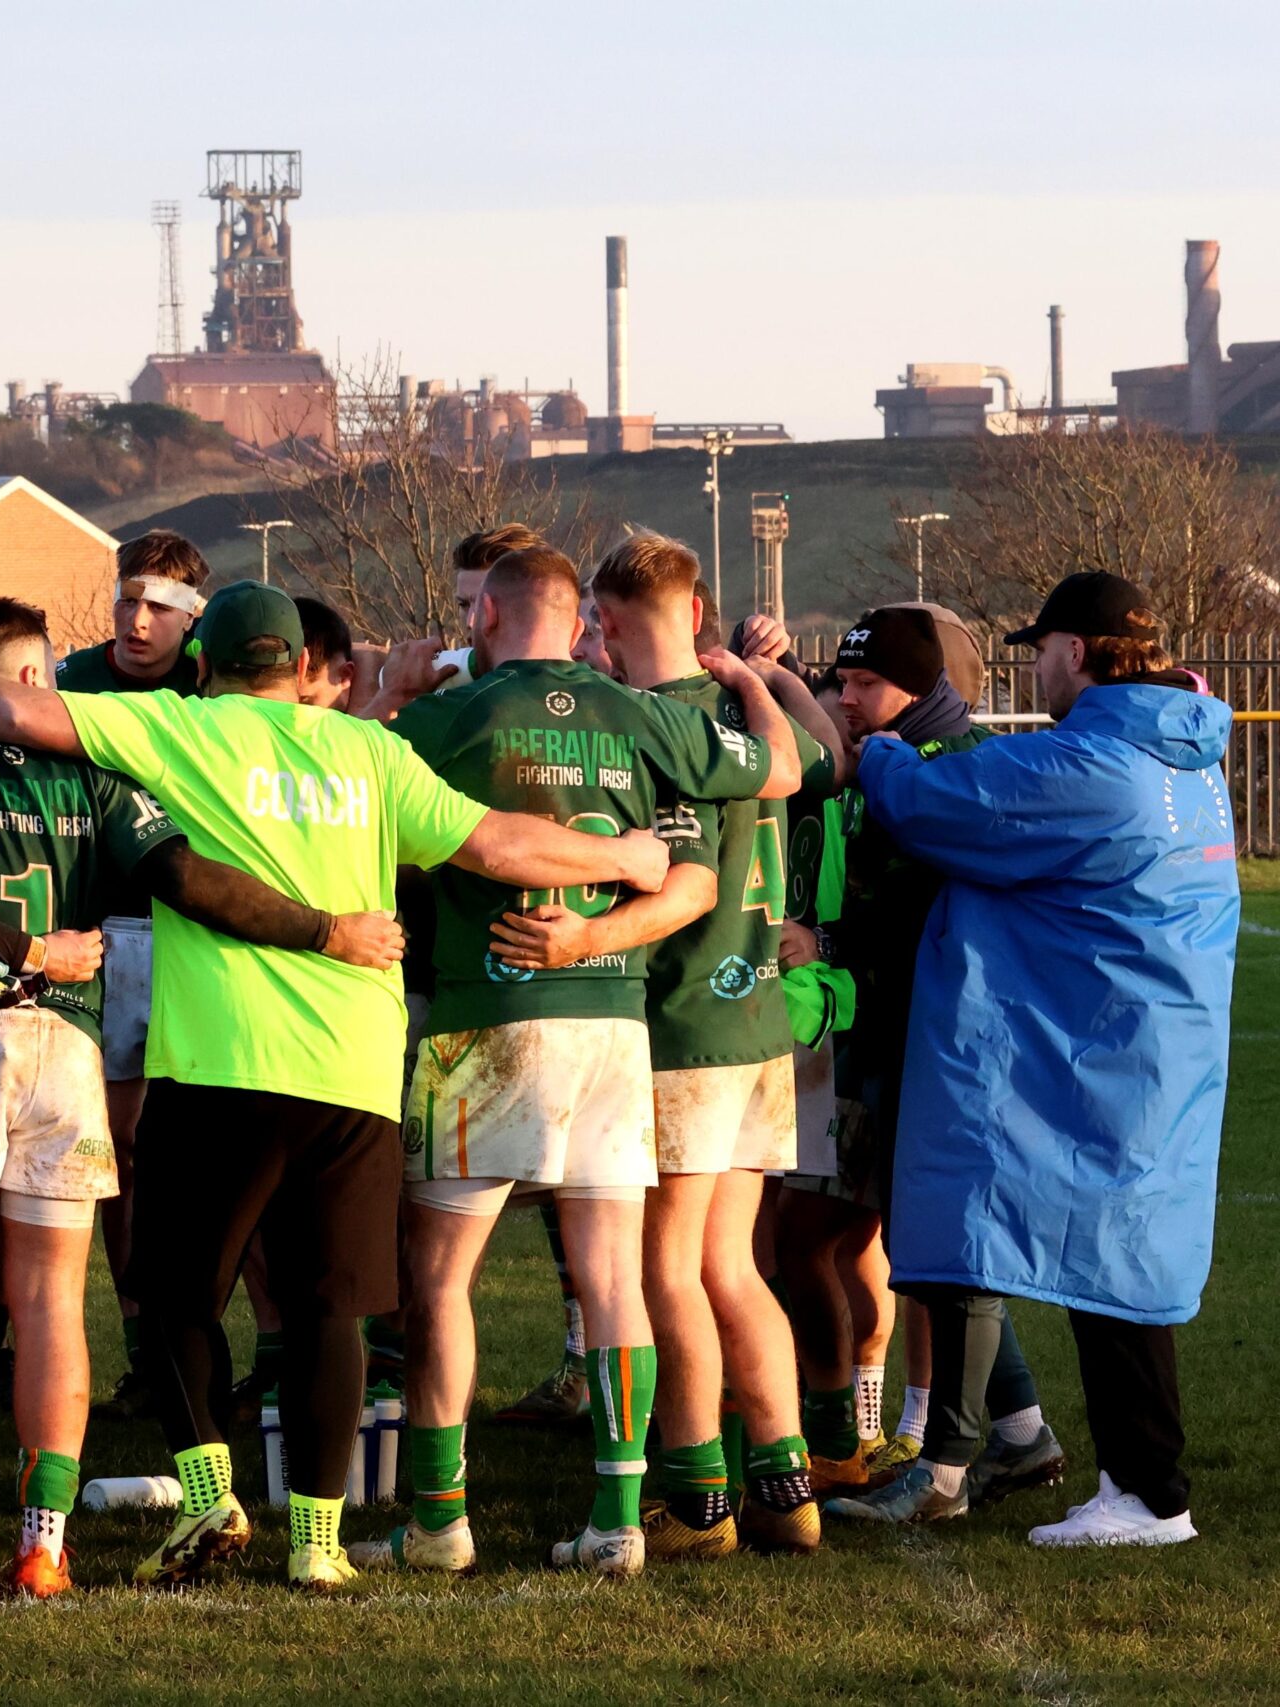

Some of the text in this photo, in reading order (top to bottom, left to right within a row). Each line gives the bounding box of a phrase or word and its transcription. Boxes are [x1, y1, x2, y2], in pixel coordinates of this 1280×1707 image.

[489, 728, 635, 787] ABERAVON
[516, 765, 632, 790] FIGHTING IRISH
[131, 790, 166, 829] JE
[247, 766, 370, 828] COACH
[1164, 776, 1179, 834] SPIRIT
[1201, 769, 1227, 829] ENTURE
[57, 816, 91, 838] IRISH
[0, 863, 53, 936] 1
[741, 816, 786, 926] 4
